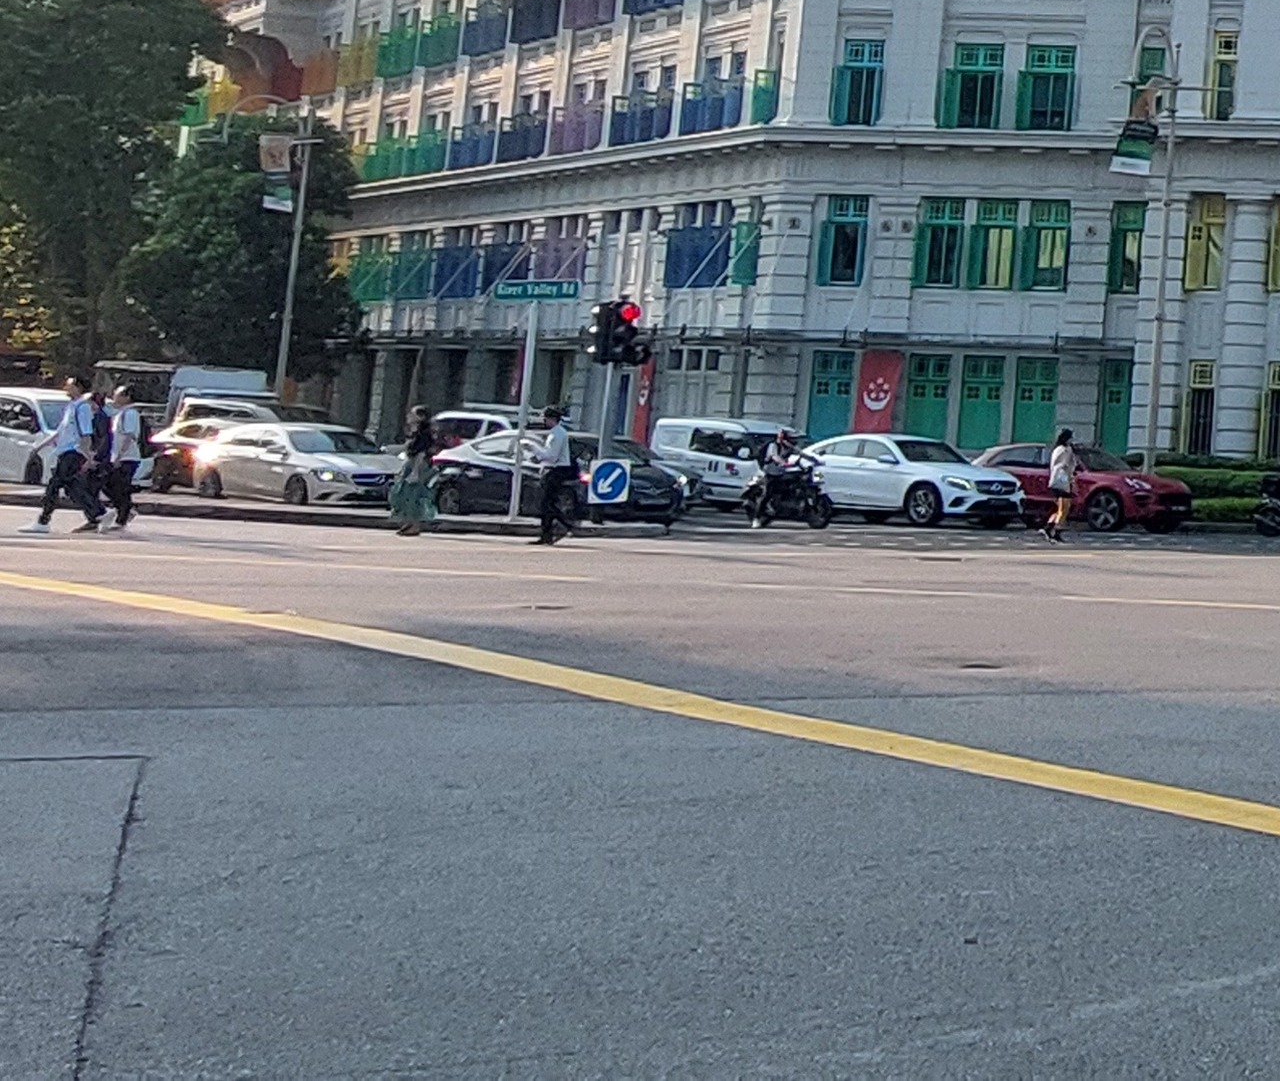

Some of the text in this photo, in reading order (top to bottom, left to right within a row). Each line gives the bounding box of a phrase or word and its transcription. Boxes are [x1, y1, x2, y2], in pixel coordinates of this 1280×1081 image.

[497, 282, 575, 297] River Valley Rd
